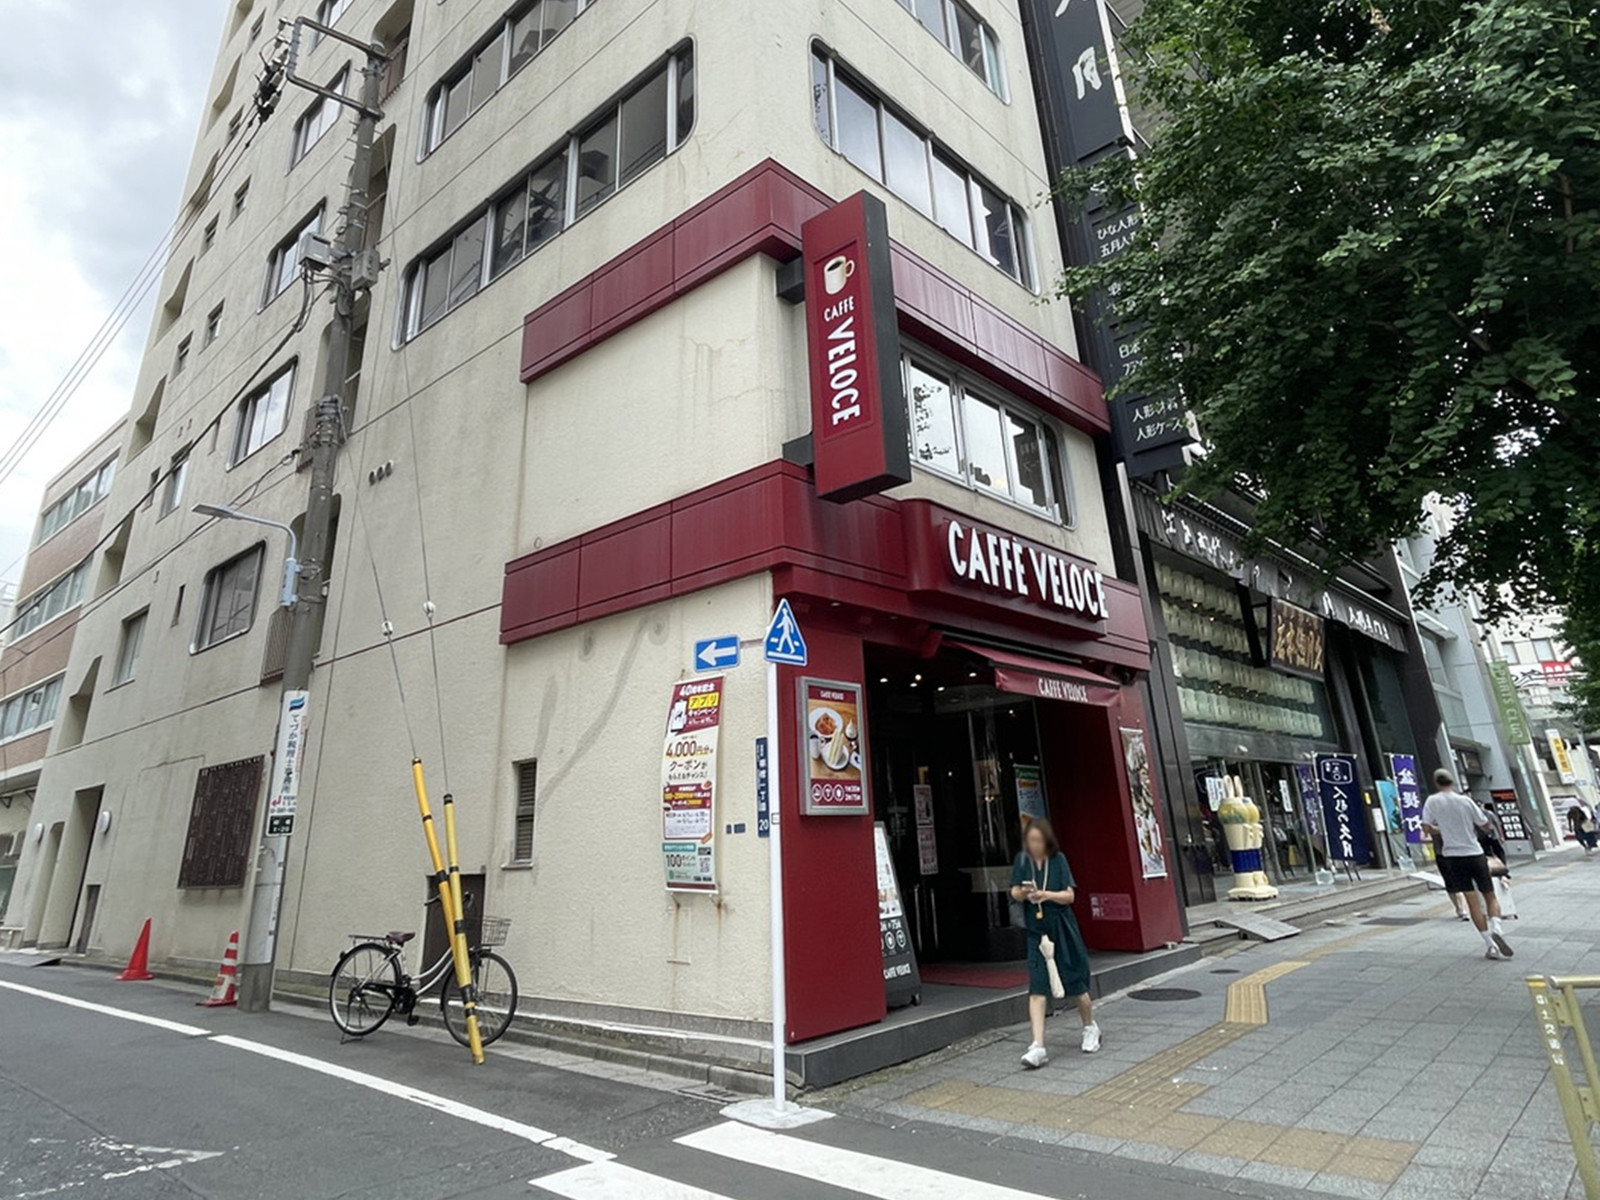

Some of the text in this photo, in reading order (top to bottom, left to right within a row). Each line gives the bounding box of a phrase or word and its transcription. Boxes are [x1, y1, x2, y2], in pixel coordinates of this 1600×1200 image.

[827, 316, 861, 426] VELOCE
[1028, 547, 1110, 619] VELOCE
[690, 693, 718, 708] アプリ
[759, 818, 769, 831] 20
